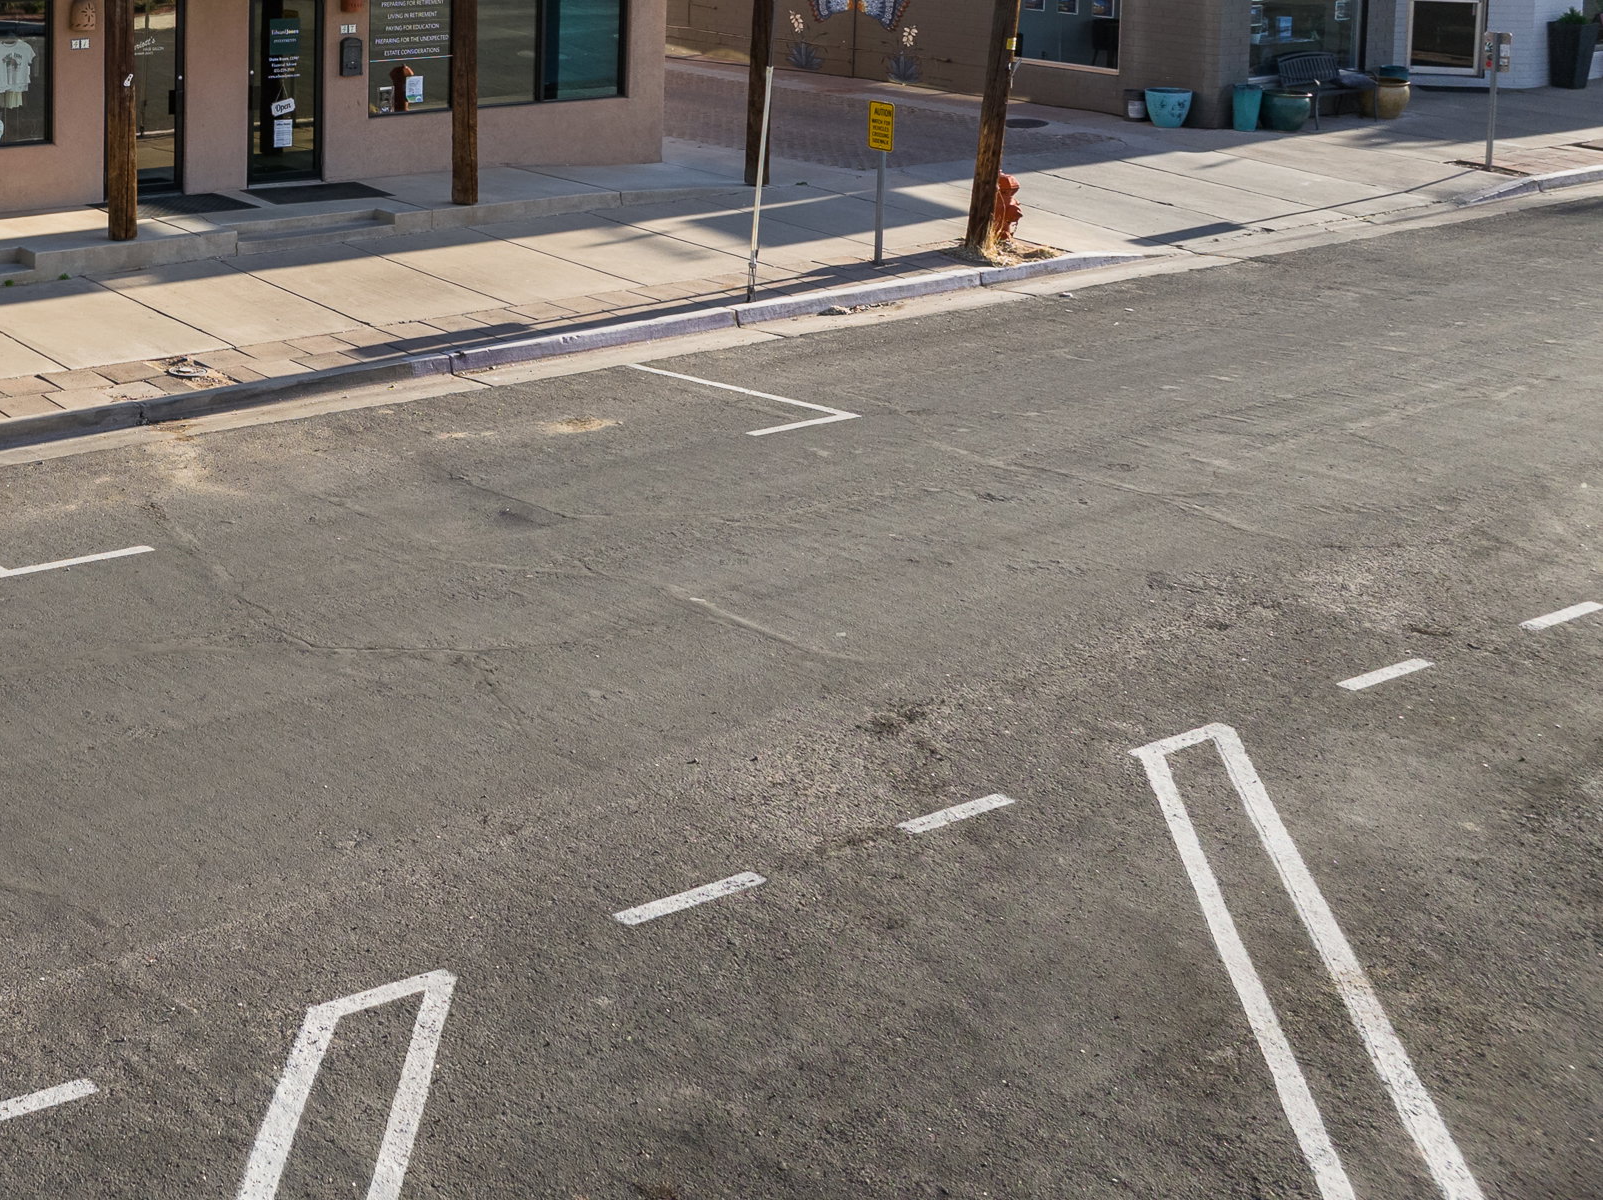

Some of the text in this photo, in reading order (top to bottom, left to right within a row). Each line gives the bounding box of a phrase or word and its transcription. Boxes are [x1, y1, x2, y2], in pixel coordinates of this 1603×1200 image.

[420, 34, 449, 42] UNEXPECTED
[401, 47, 440, 55] CONSIDERATIONS
[275, 102, 291, 113] Open
